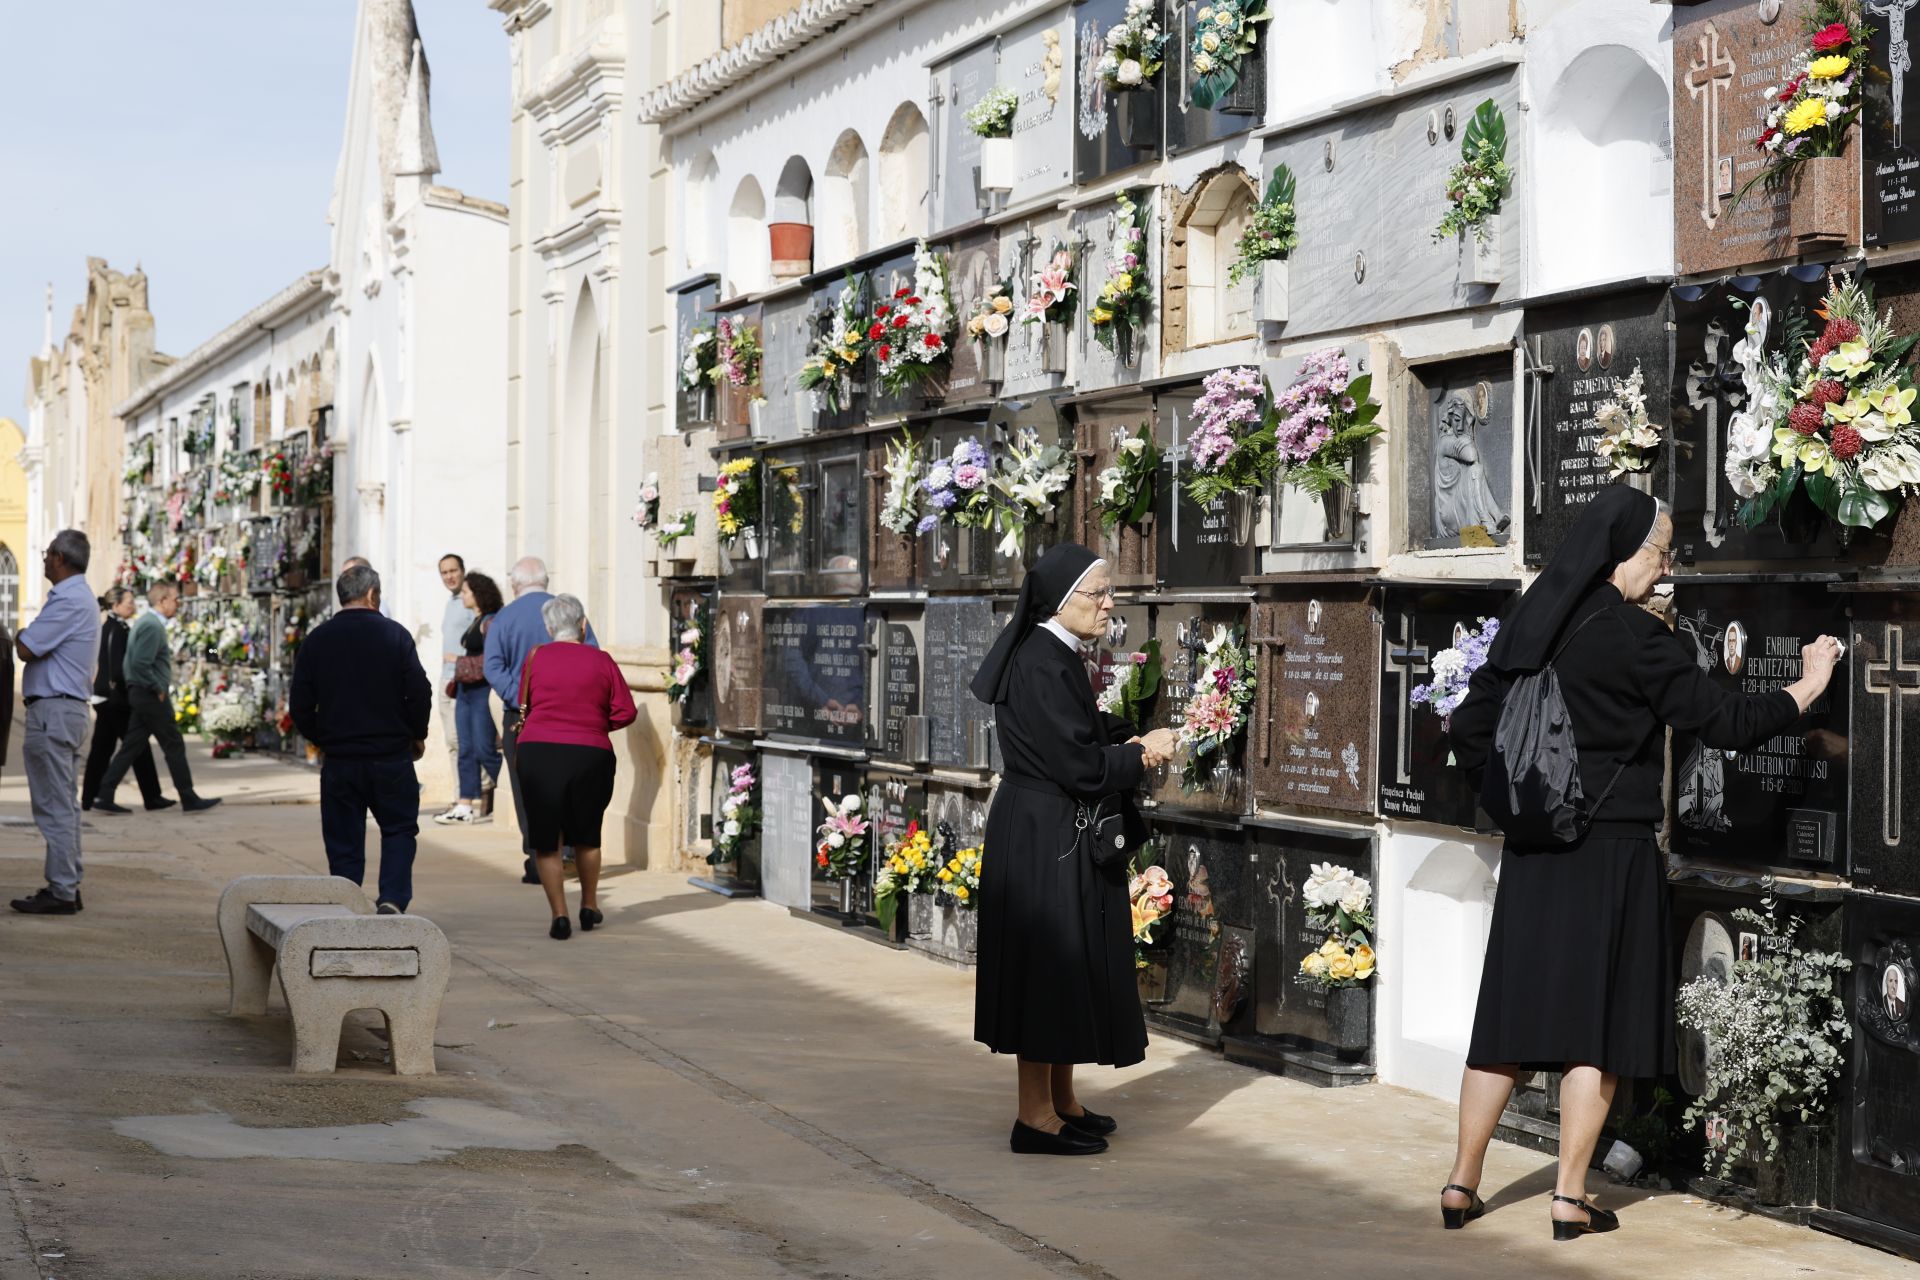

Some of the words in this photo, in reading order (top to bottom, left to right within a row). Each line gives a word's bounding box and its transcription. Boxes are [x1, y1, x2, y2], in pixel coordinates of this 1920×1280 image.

[1751, 42, 1797, 66] FRANCISCO
[1573, 376, 1620, 396] REMEDIOS
[1766, 635, 1801, 658] ENRIQUE
[1748, 657, 1783, 678] BENITEZ
[1784, 658, 1804, 678] PINT
[1768, 735, 1807, 755] DOLORES
[1738, 754, 1784, 776] CALDERON
[1298, 782, 1330, 795] recordamos
